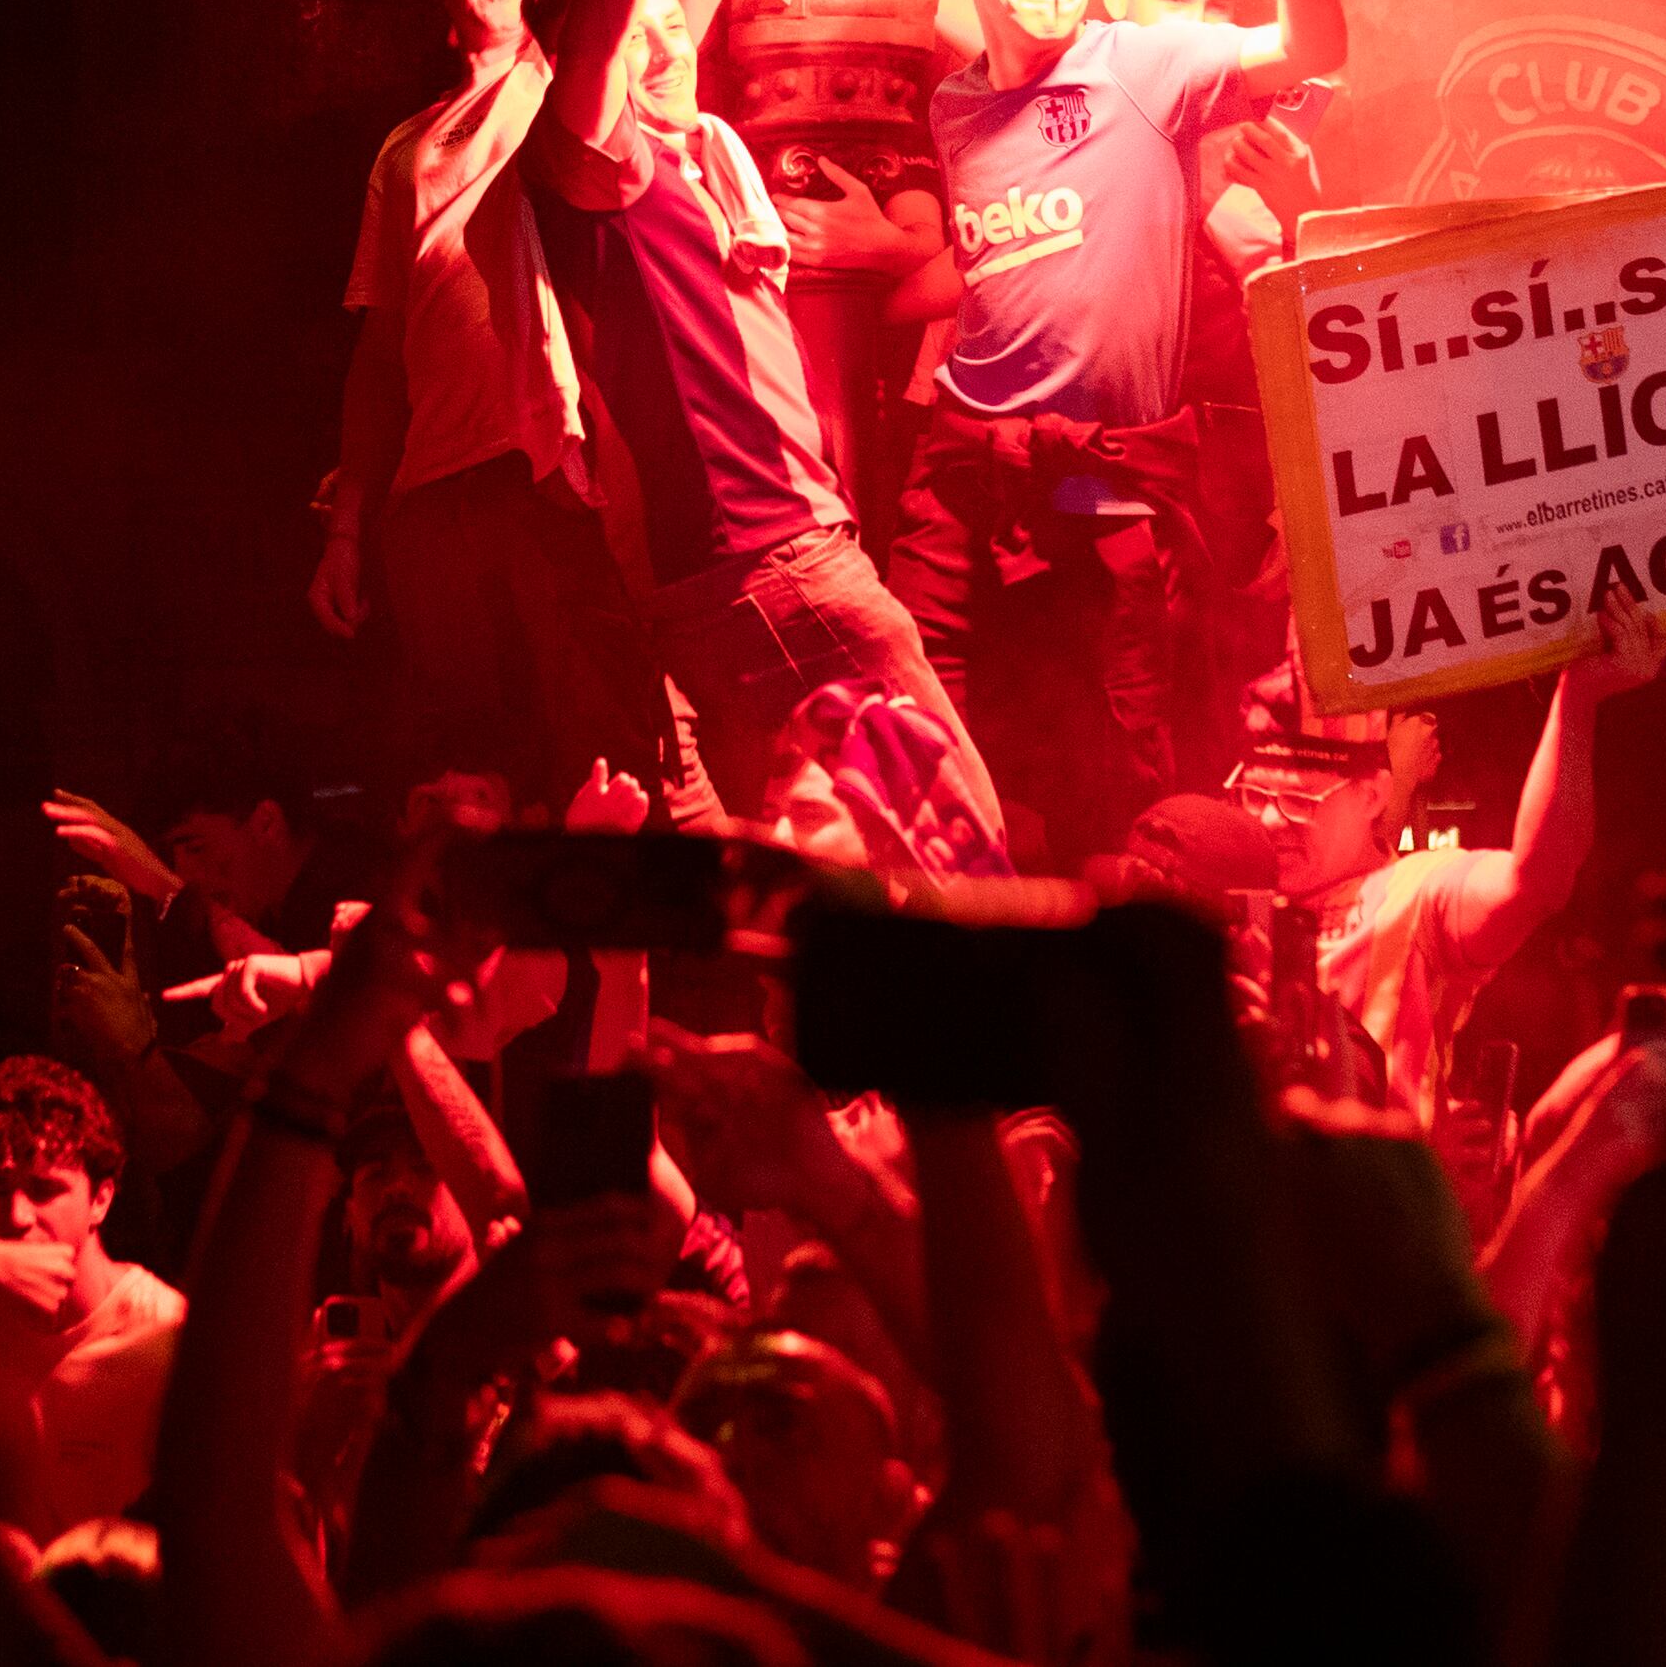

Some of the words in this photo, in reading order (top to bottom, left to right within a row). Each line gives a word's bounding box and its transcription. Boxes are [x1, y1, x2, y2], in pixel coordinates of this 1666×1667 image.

[1488, 60, 1662, 126] CLUB
[955, 186, 1083, 254] beko
[1333, 434, 1455, 517] LA
[1349, 586, 1467, 668] JA
[1477, 564, 1573, 639] ÉS
